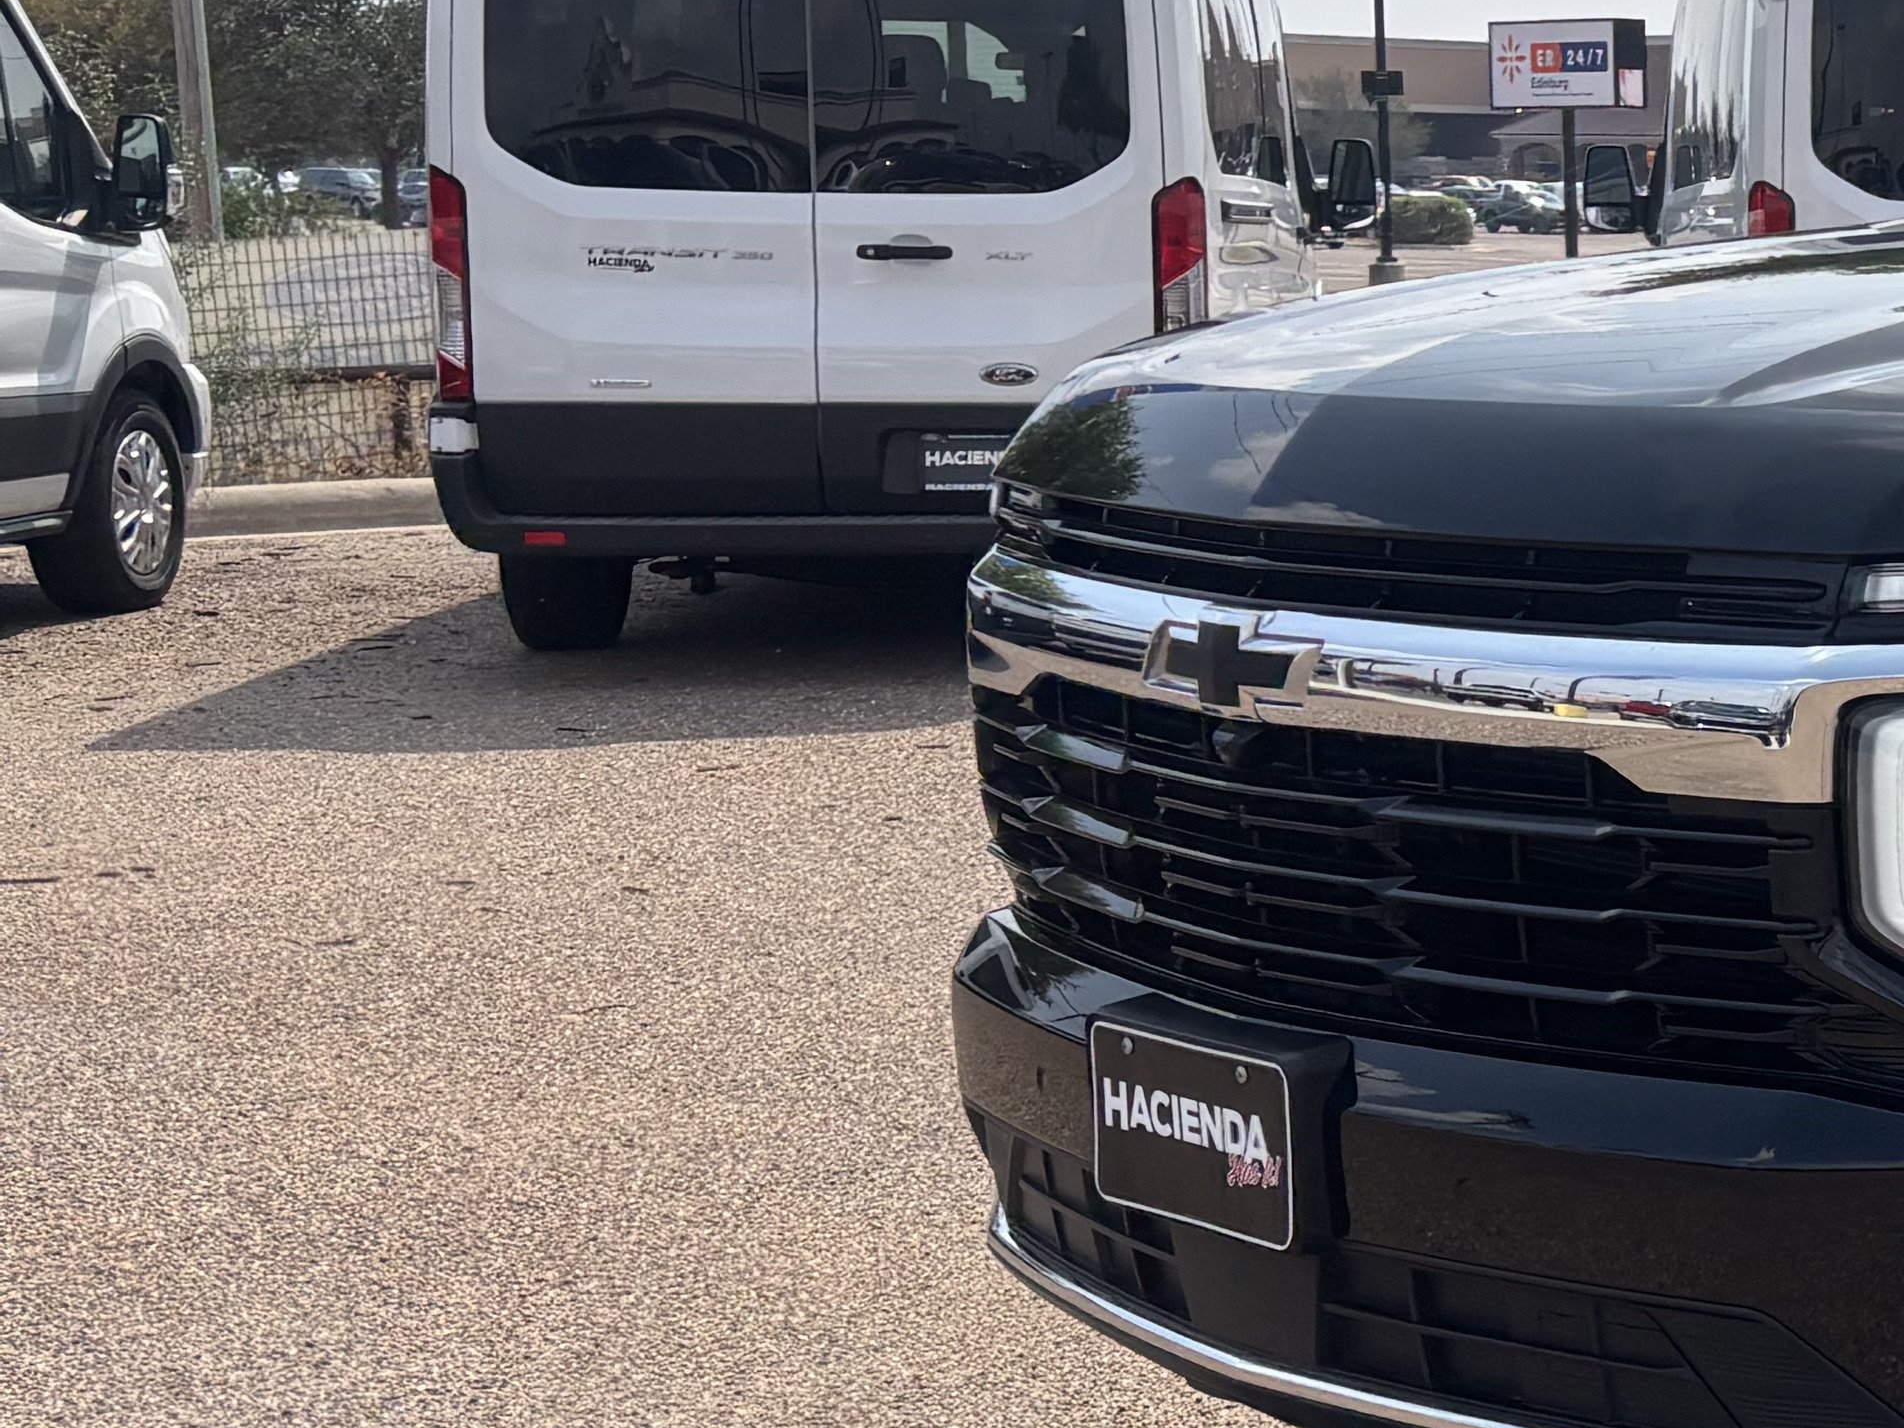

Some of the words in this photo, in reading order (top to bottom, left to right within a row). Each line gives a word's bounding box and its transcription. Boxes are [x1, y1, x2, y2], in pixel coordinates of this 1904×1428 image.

[1536, 49, 1554, 67] ER
[1567, 48, 1604, 67] 24/7
[588, 257, 652, 269] HACIENDA
[1102, 1076, 1268, 1165] HACIENDA
